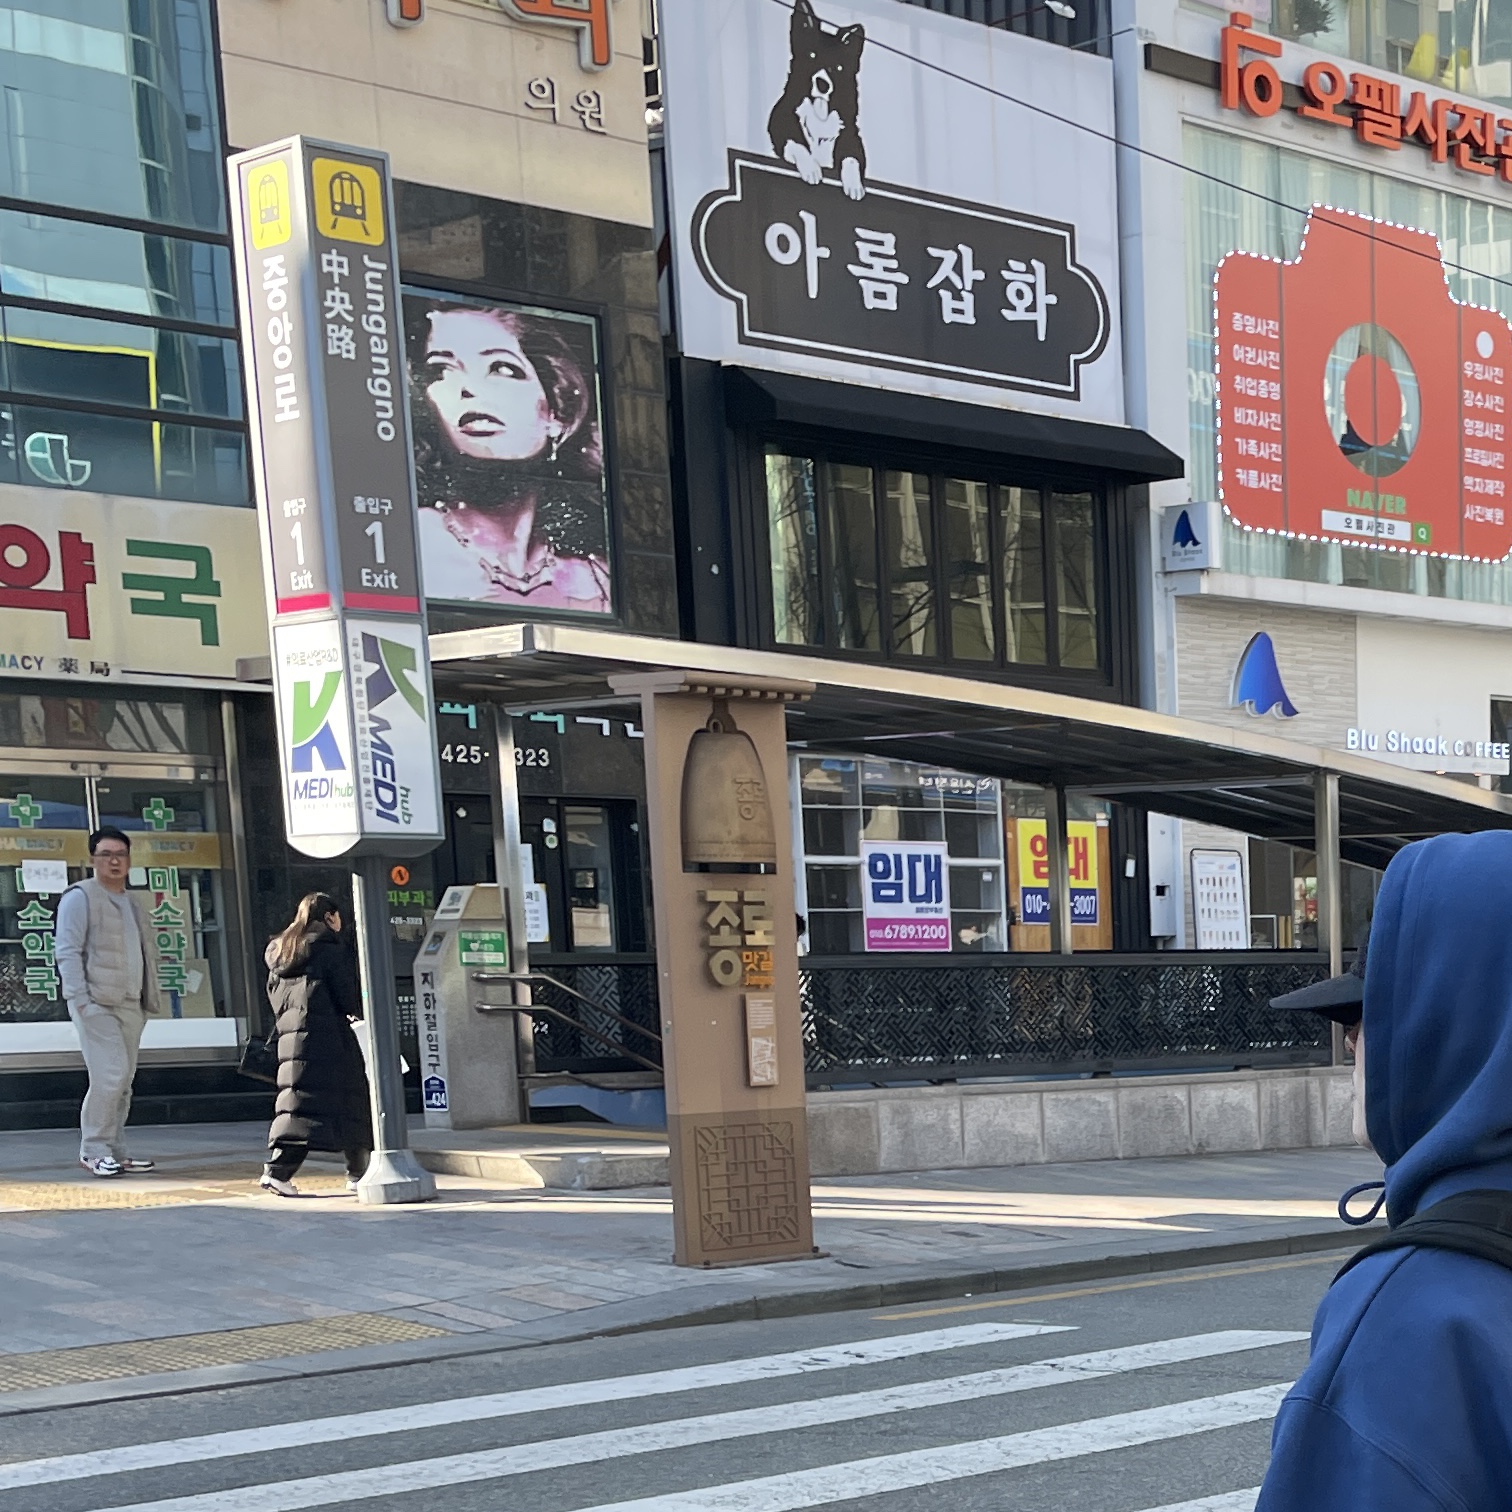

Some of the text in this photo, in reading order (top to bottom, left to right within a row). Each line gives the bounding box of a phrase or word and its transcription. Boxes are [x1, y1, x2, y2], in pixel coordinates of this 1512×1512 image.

[525, 77, 608, 136] 의원
[764, 210, 1058, 341] 아롬잡화
[320, 249, 356, 360] 中央路
[1232, 312, 1280, 338] 증명사진
[262, 255, 300, 424] 중앙로
[362, 255, 397, 442] Jungangno
[1233, 344, 1280, 370] 여권사진
[1233, 375, 1281, 400] 취업증명
[1463, 389, 1504, 413] 장수사진
[1234, 407, 1282, 431] 비자사진
[1463, 418, 1504, 441] 영정사진
[1234, 438, 1282, 462] 가족사진
[1236, 469, 1283, 492] 커플사진
[353, 496, 393, 516] 출입구
[1347, 488, 1406, 514] NAVER
[290, 521, 304, 565] 1
[364, 521, 385, 564] 1
[290, 570, 313, 591] Exit
[361, 569, 399, 590] Exit
[1346, 728, 1511, 759] Blu Shaak COFFEE
[368, 711, 401, 824] MEDI
[399, 785, 414, 825] hub
[293, 777, 354, 800] MEDI hub
[868, 852, 943, 904] 임대
[16, 867, 60, 1000] 소약국
[148, 866, 189, 997] 미소약국
[742, 951, 773, 972] 맛길
